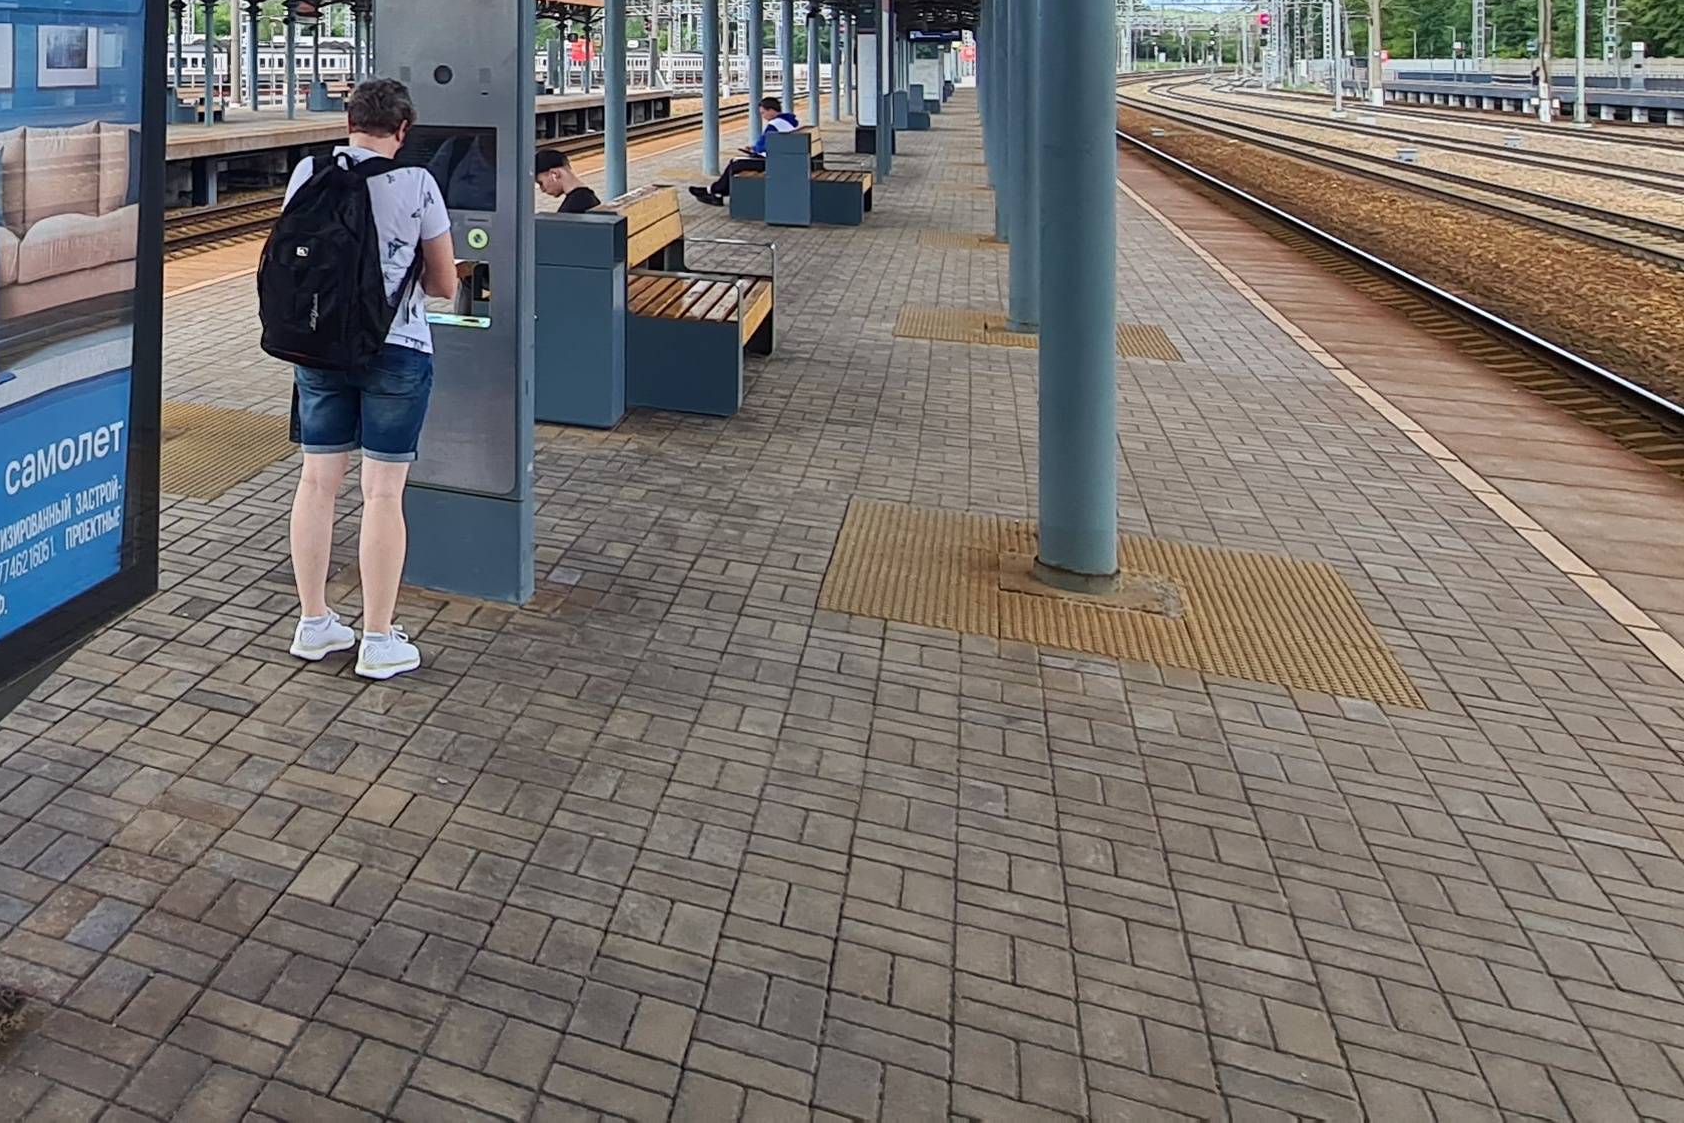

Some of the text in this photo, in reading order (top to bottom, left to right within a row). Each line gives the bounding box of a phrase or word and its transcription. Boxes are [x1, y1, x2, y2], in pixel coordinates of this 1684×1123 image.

[4, 420, 125, 496] самолет
[75, 474, 123, 516] ЗАСТРОЙ-
[65, 505, 122, 551] ПРОЕКТНЫЕ
